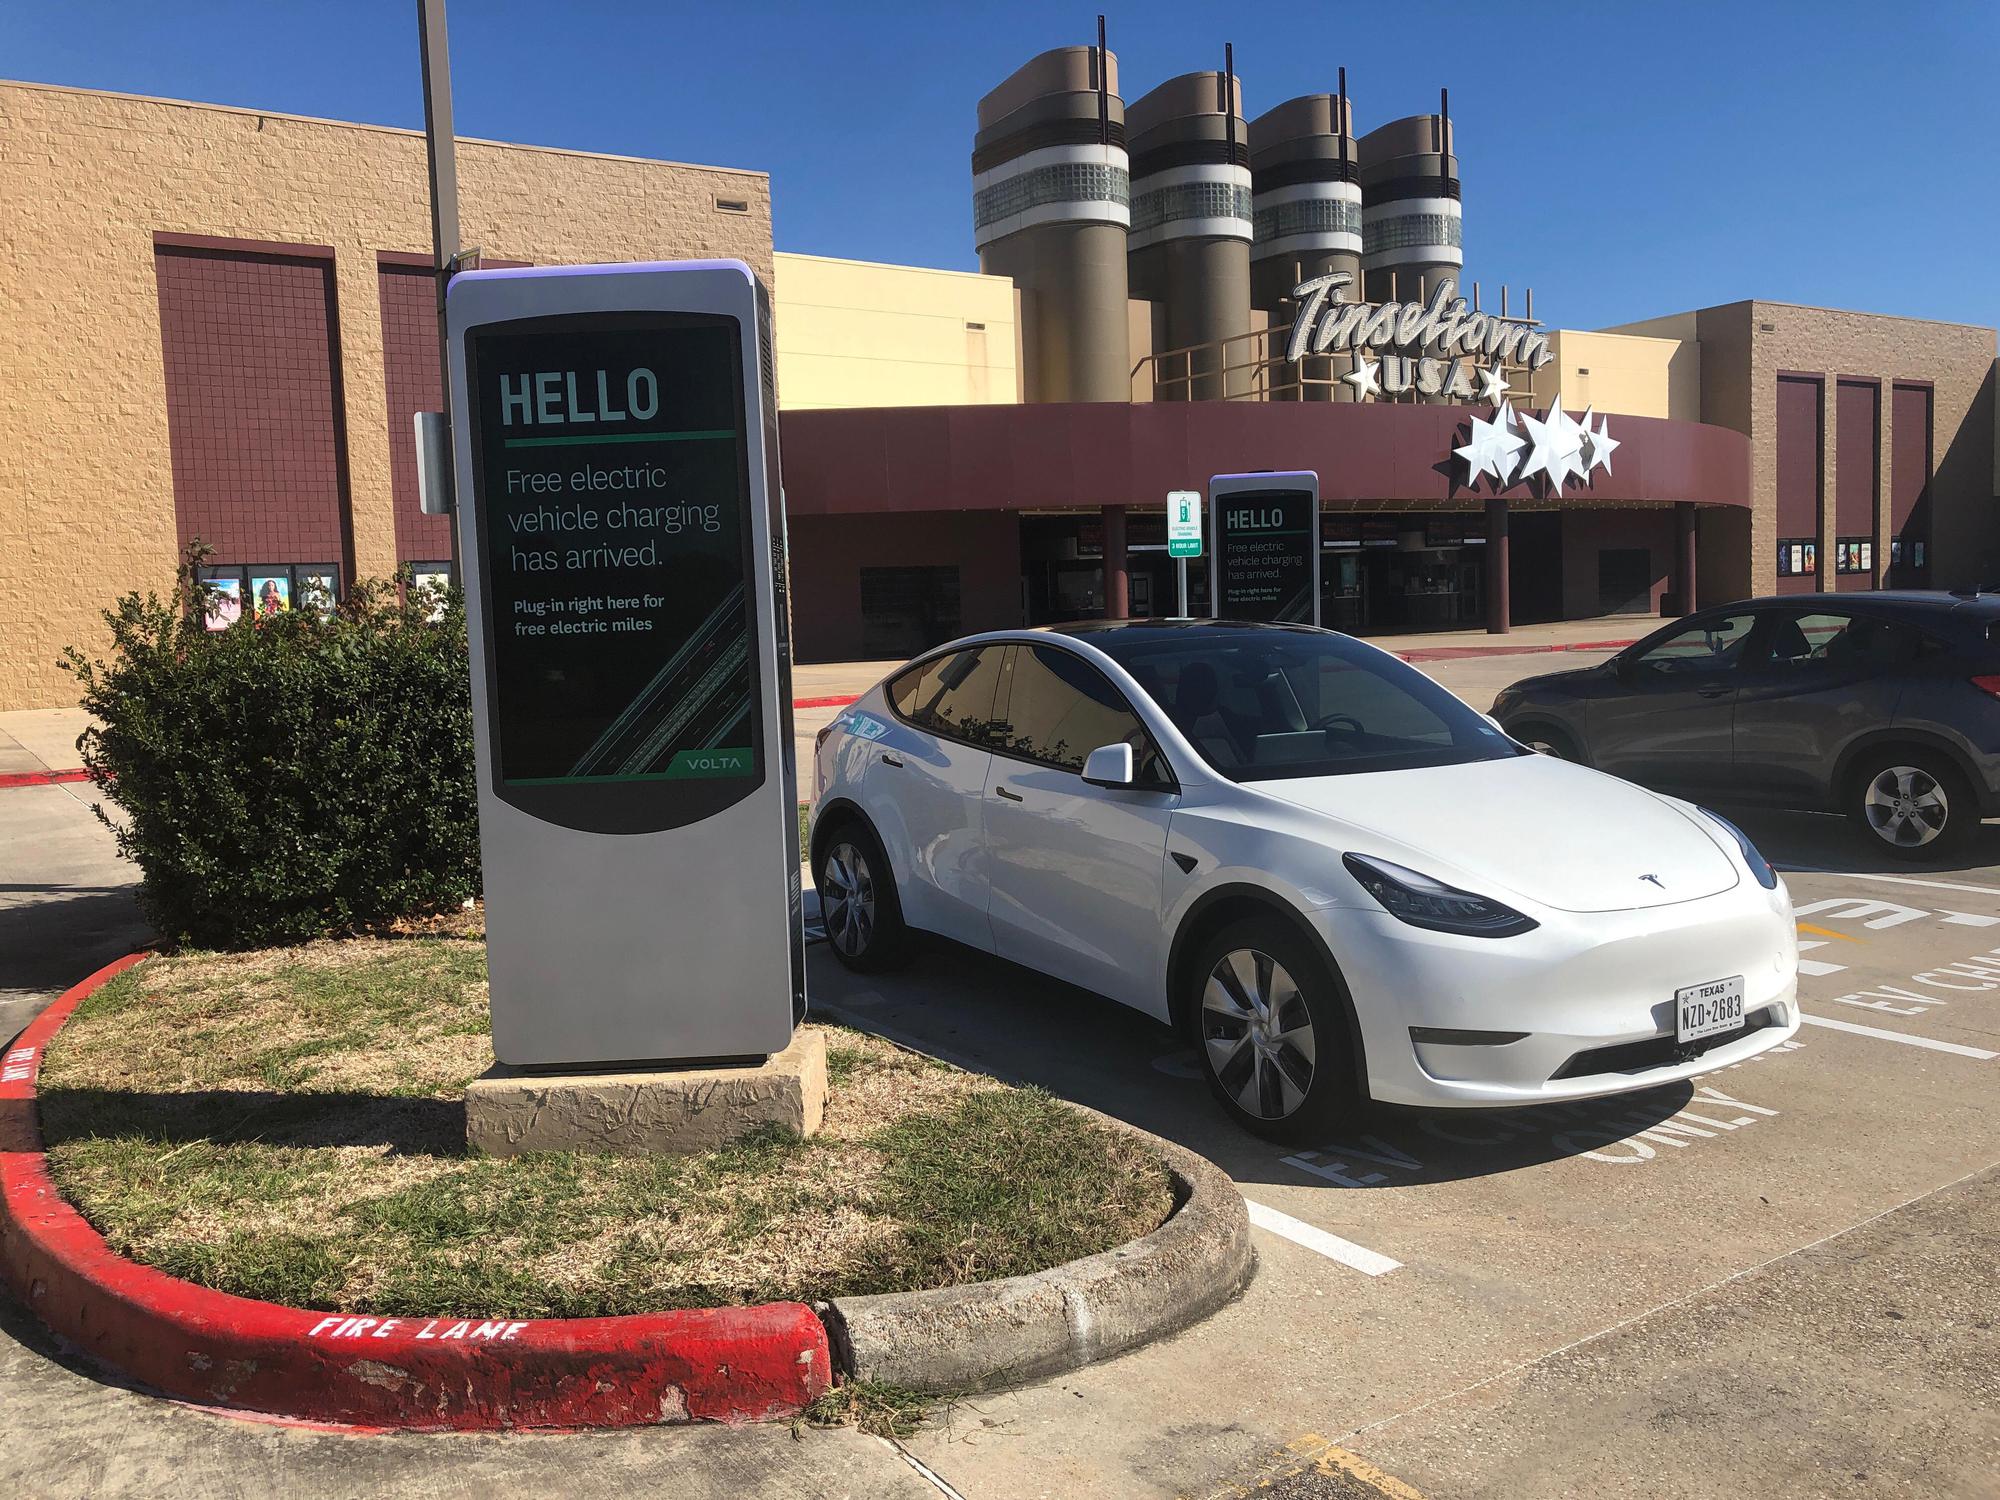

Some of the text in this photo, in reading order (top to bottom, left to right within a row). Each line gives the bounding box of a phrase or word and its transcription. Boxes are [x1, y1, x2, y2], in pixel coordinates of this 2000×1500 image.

[1286, 271, 1556, 369] Tinseltown
[1380, 354, 1475, 400] USA
[500, 367, 659, 425] HELLO
[507, 462, 667, 494] Free electric
[508, 500, 720, 533] vehicle charging
[1227, 508, 1283, 529] HELLO
[512, 539, 663, 571] has arrived.
[1227, 542, 1284, 552] Free electric
[1227, 554, 1303, 567] vehicle charging
[1228, 568, 1281, 579] has arrived.
[514, 594, 664, 617] Plug-in right here for
[515, 617, 653, 636] free electric miles
[687, 758, 742, 770] VOLTA
[1700, 984, 1724, 998] TEXAS
[1833, 985, 1948, 1015] EV
[1552, 1086, 1780, 1164] ONLY
[1279, 1134, 1423, 1188] EV
[308, 1318, 529, 1341] FIRE LANE
